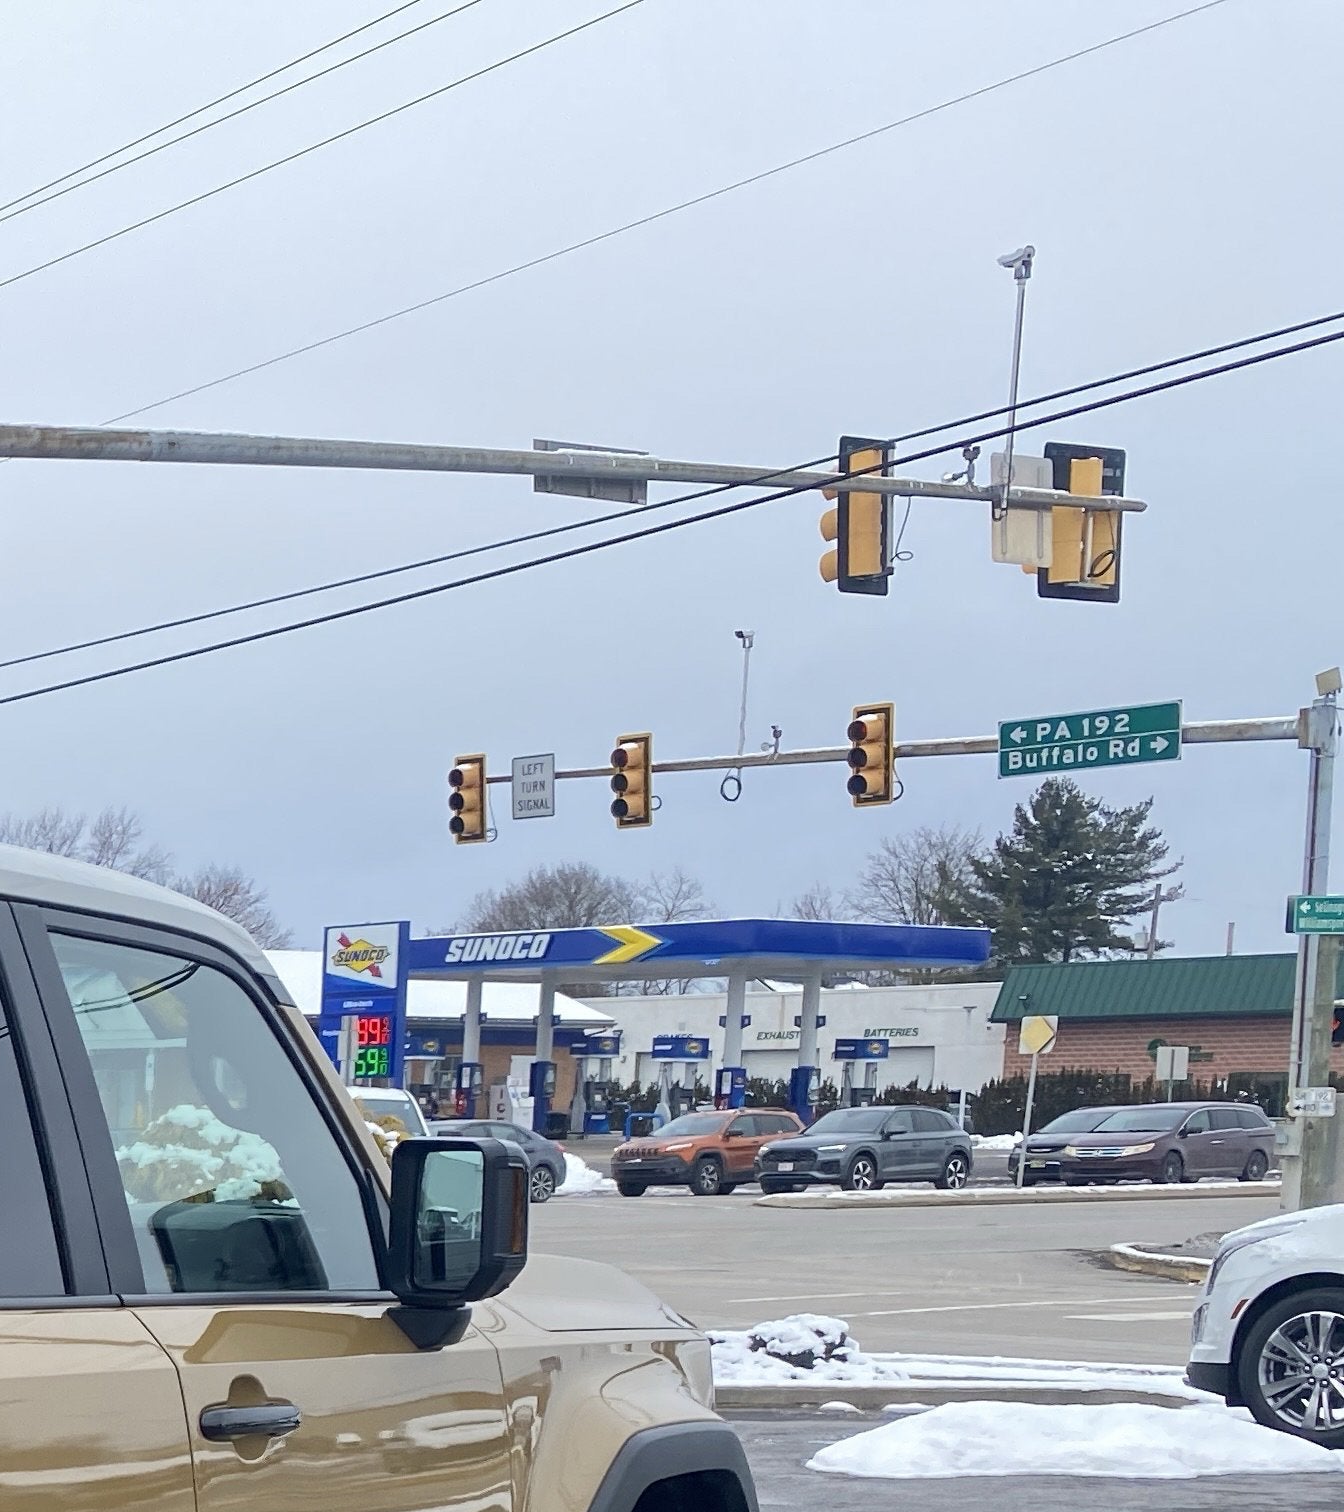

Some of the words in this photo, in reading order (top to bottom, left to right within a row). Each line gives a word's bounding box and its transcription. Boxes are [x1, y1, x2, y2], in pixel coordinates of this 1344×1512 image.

[1036, 720, 1072, 742] PA
[1081, 713, 1131, 737] 192
[1008, 743, 1098, 770] Buffalo
[1108, 737, 1141, 759] Rd
[521, 762, 545, 777] LEFT
[520, 780, 546, 794] TURN
[517, 798, 551, 812] SIGNAL
[444, 933, 551, 963] SUNOCO
[336, 949, 386, 963] SUNOCO
[756, 1030, 801, 1041] EXHAUST
[863, 1027, 920, 1038] BATTERIES
